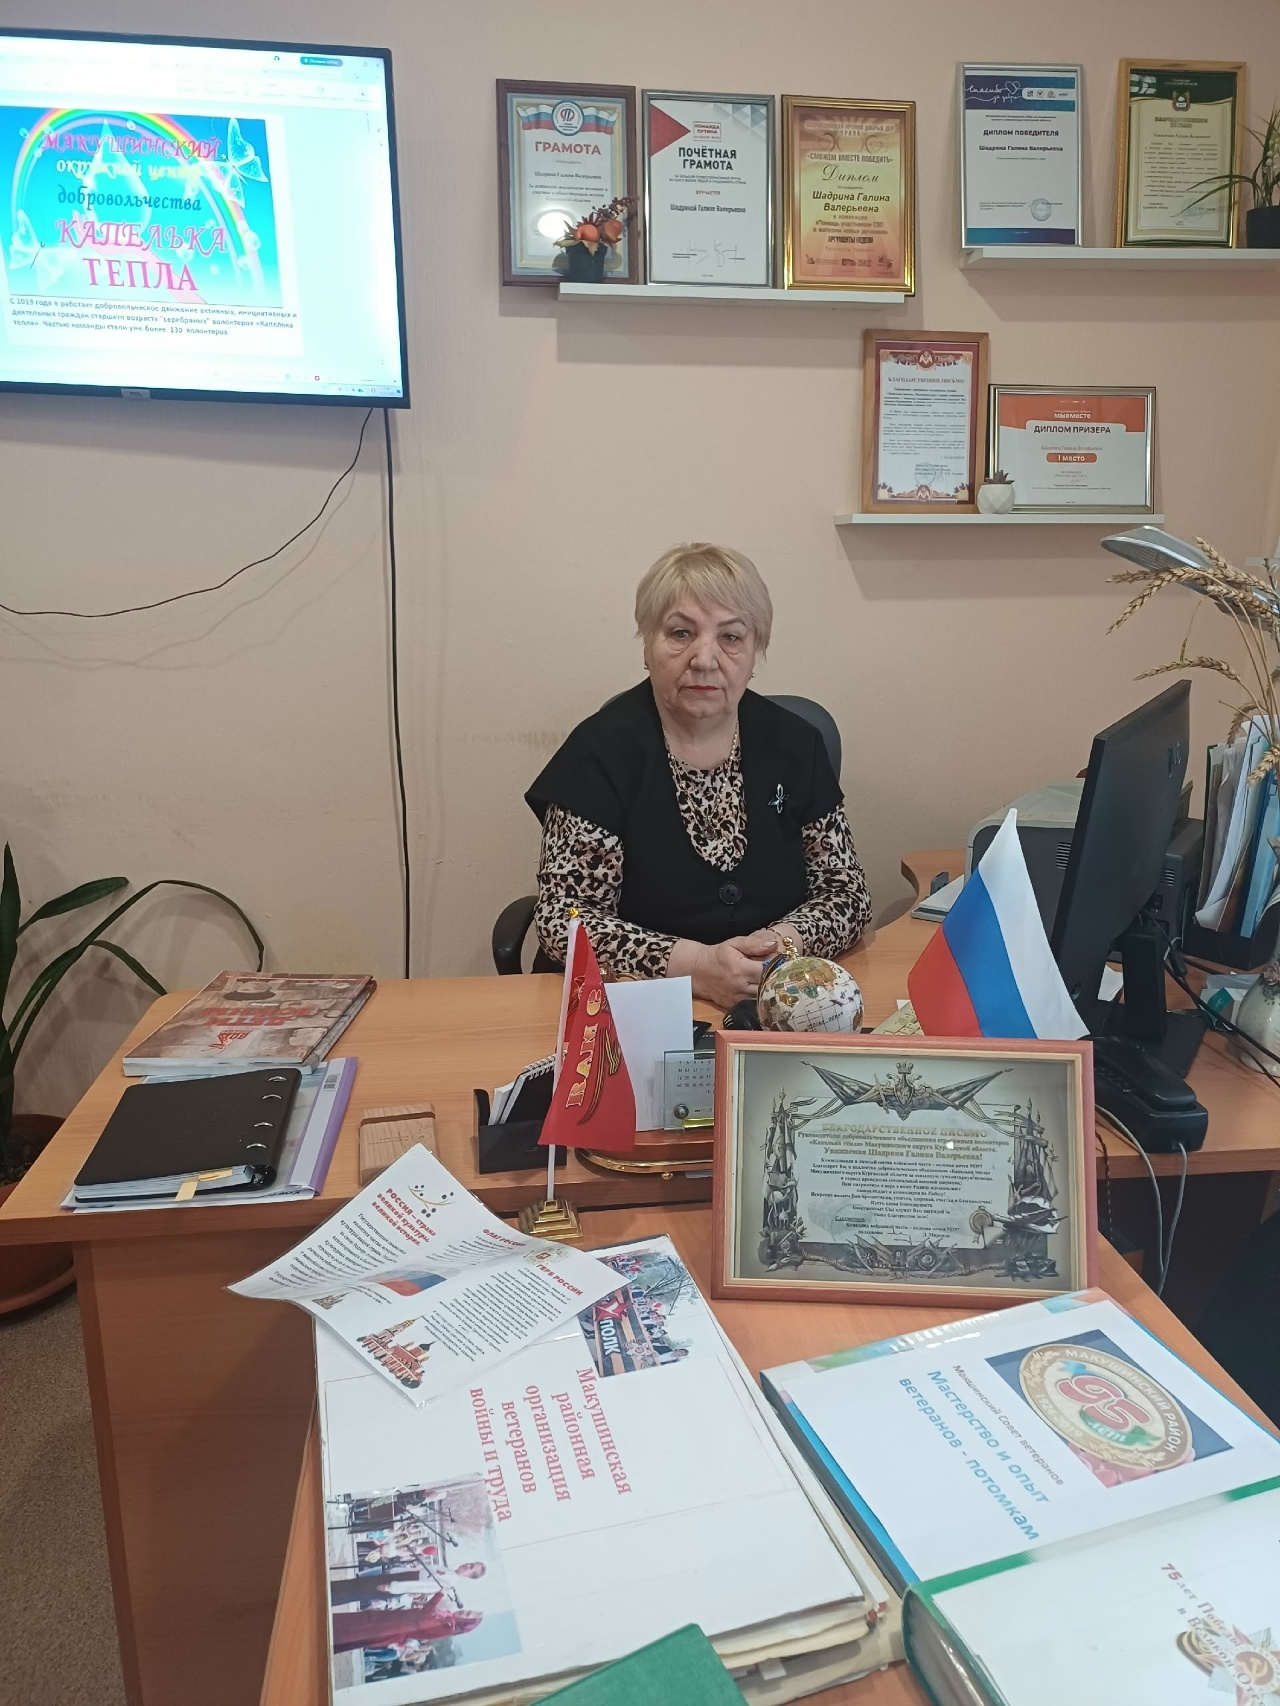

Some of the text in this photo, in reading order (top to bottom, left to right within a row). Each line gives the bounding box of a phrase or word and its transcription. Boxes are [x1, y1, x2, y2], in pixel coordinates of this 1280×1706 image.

[42, 133, 222, 160] МАКУШИНСКИЙ
[535, 141, 602, 155] ГРАМОТА
[679, 145, 737, 159] ПОЧЁТНАЯ
[683, 159, 733, 170] ГРАМОТА
[822, 163, 880, 183] Диплом
[57, 184, 202, 211] добровольчества
[812, 190, 890, 202] Шадрина Галина
[823, 202, 880, 213] Валерьевна
[54, 218, 229, 257] КАПЕЛЬКА
[83, 257, 199, 292] ТЕПЛА
[36, 300, 52, 308] года
[60, 301, 93, 309] работает
[161, 306, 198, 315] движение
[43, 320, 70, 328] Частью
[71, 322, 105, 331] команды
[1034, 425, 1111, 434] ДИПЛОМ ПРИЗЕРА
[206, 1017, 293, 1028] ДЕТИ
[822, 1123, 988, 1138] БЛАГОДАРСТВЕННОЕ ПИСЬМО
[824, 1147, 983, 1161] Уважаемая Шадрина Галина Валерьевна!
[371, 1202, 398, 1227] великой
[377, 1193, 404, 1220] великой
[386, 1188, 413, 1216] РОССИЯ
[415, 1219, 436, 1237] страна
[536, 1263, 583, 1296] ГЕРБ РОССИИ
[600, 1320, 621, 1356] ПОЛК
[1056, 1374, 1151, 1431] 95
[1065, 1349, 1182, 1453] МАКУШИНСКИЙ РАЙОН
[523, 1384, 571, 1502] организация
[551, 1391, 596, 1481] районная
[576, 1366, 632, 1496] Макушинская
[928, 1370, 1049, 1503] Мастерство и опыт
[1086, 1418, 1127, 1443] лет
[469, 1387, 512, 1523] войны и труда
[501, 1400, 537, 1495] ветеранов
[899, 1378, 962, 1448] ветеранов
[965, 1459, 1039, 1541] потомкам
[998, 1415, 1022, 1440] Совет
[1020, 1439, 1064, 1486] ветеранов
[1160, 1562, 1242, 1647] 75 лет Победы
[1187, 1616, 1235, 1668] Великой
